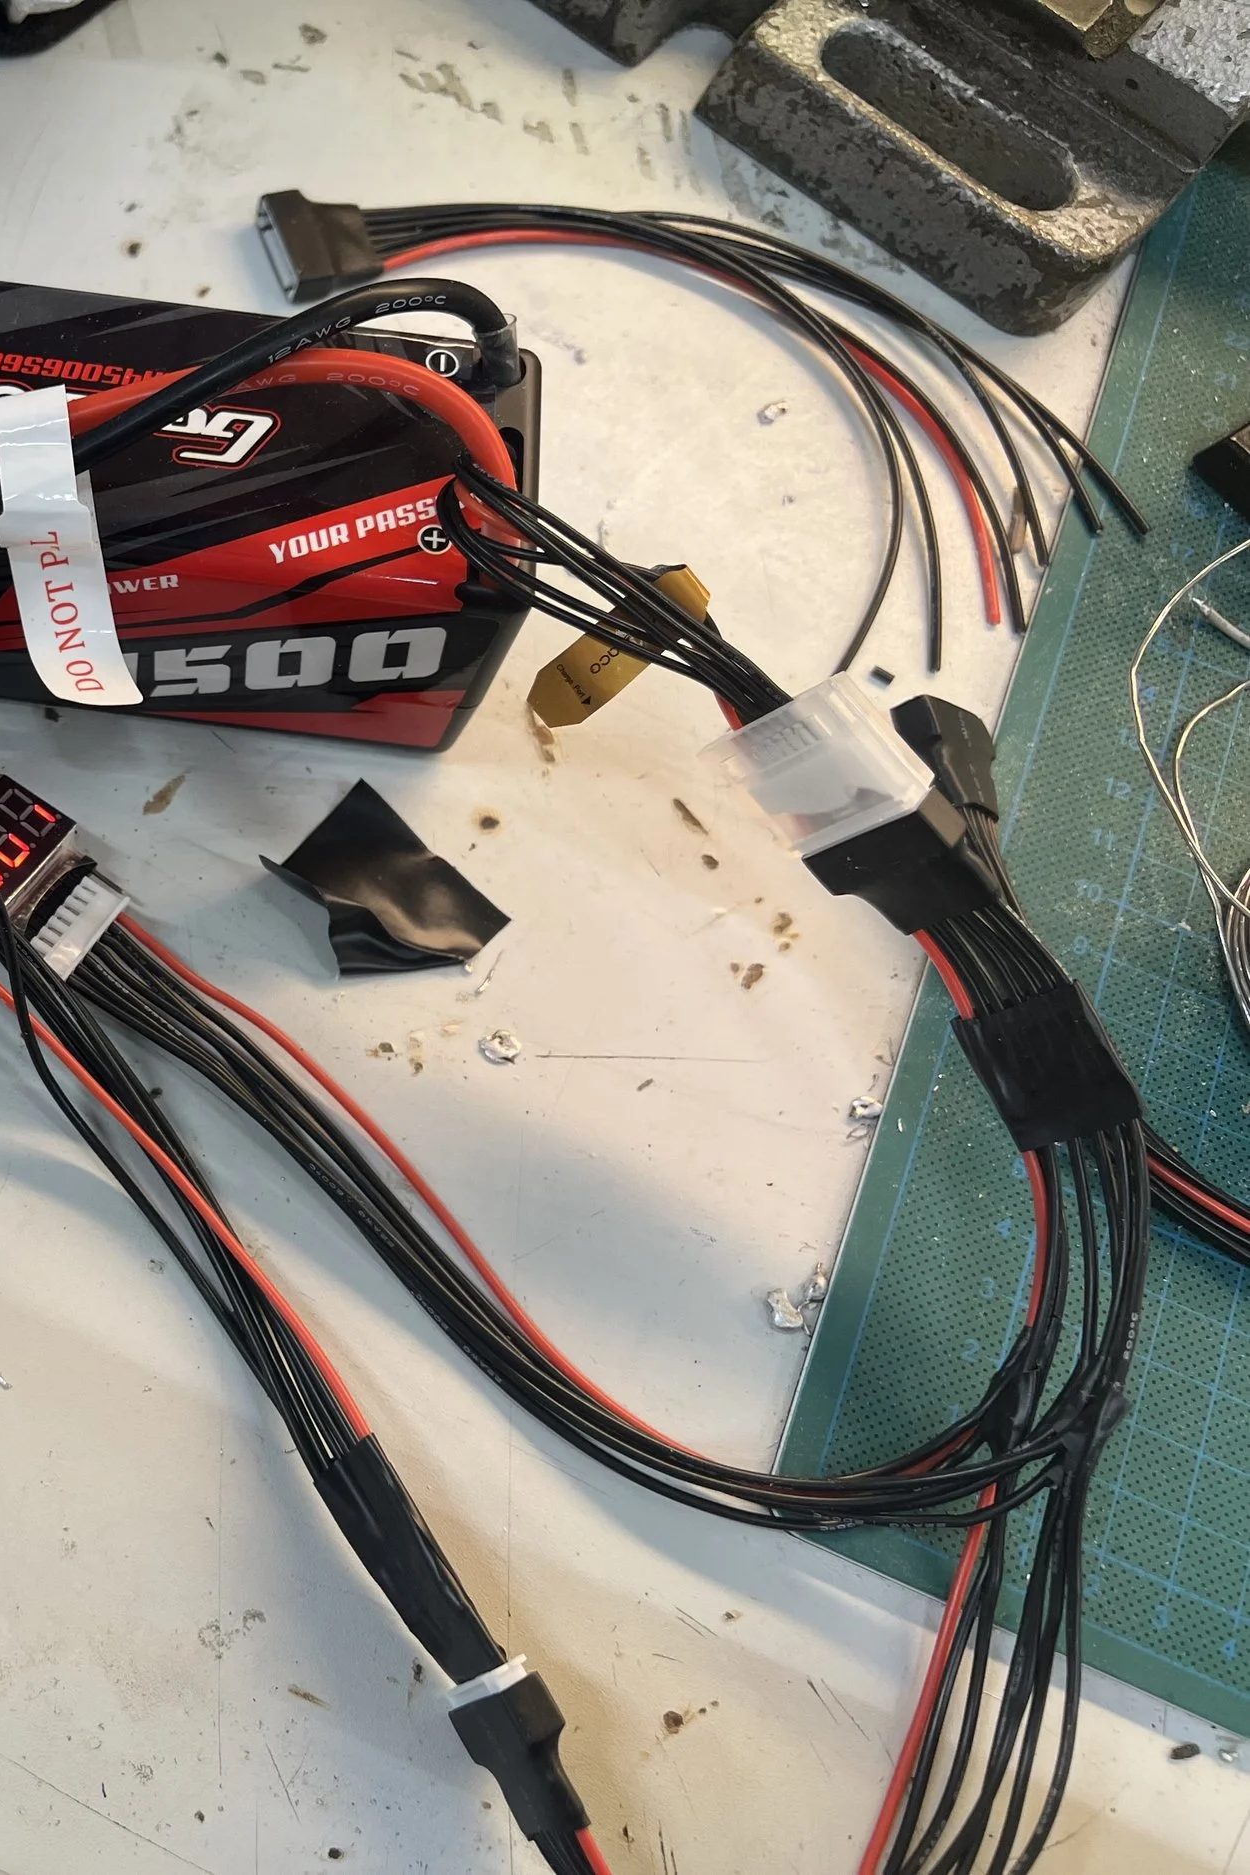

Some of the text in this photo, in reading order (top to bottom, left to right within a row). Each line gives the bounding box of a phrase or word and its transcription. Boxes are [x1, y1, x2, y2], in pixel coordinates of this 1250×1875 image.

[268, 295, 447, 364] 12AWG 200°C
[236, 372, 421, 396] AWG 200°C
[268, 498, 438, 564] YOUR PASS
[107, 574, 179, 595] WER
[44, 580, 86, 653] NOT
[66, 660, 105, 692] DO
[122, 627, 447, 698] 500
[555, 662, 586, 699] Charge Port
